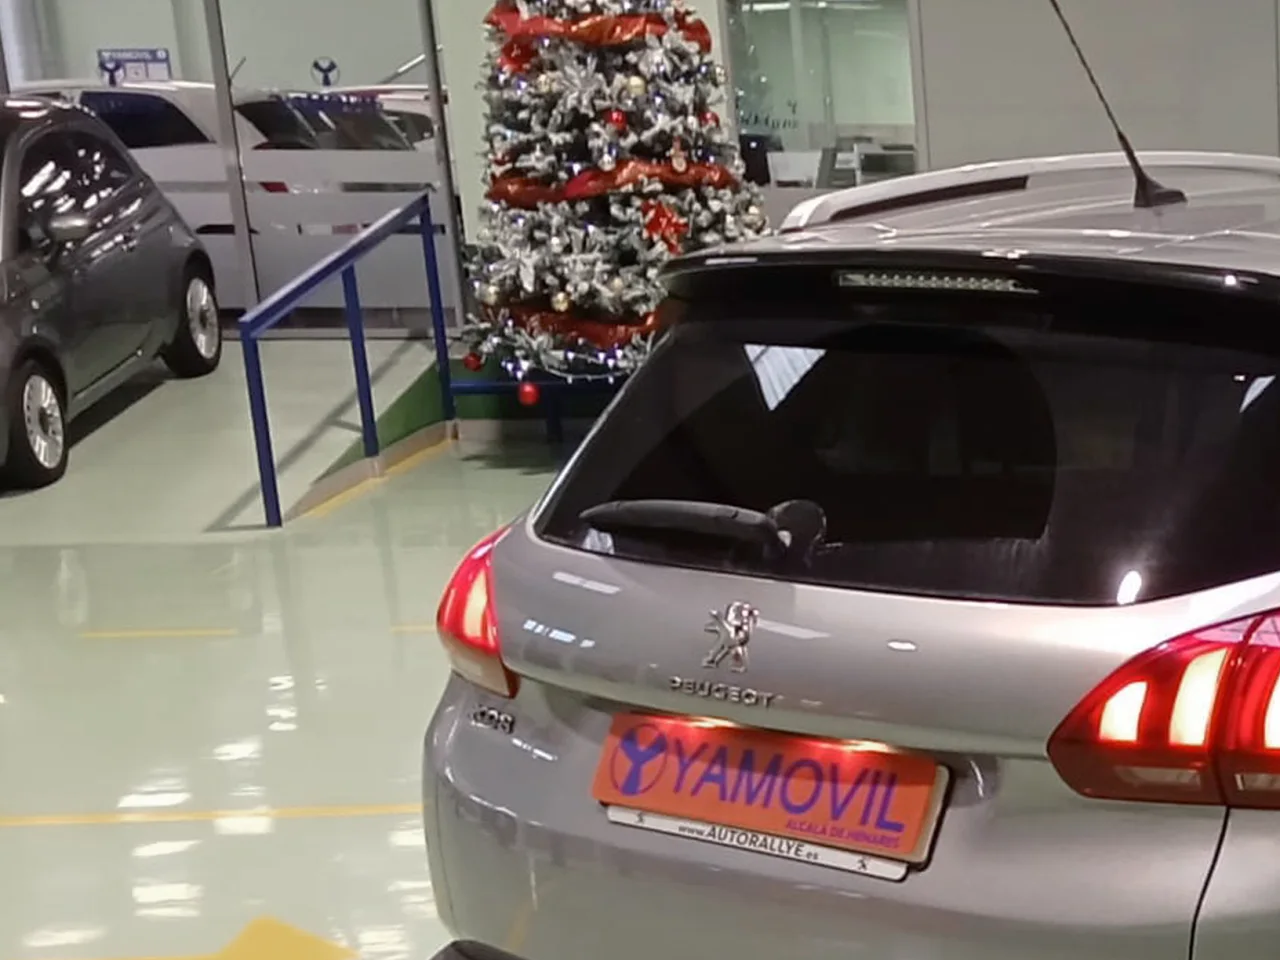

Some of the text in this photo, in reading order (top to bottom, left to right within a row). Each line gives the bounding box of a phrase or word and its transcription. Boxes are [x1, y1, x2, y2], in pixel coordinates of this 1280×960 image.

[669, 676, 774, 708] PEUGEOT
[671, 738, 904, 832] YAMOVIL
[679, 825, 819, 861] www.AUTORALLYE.es
